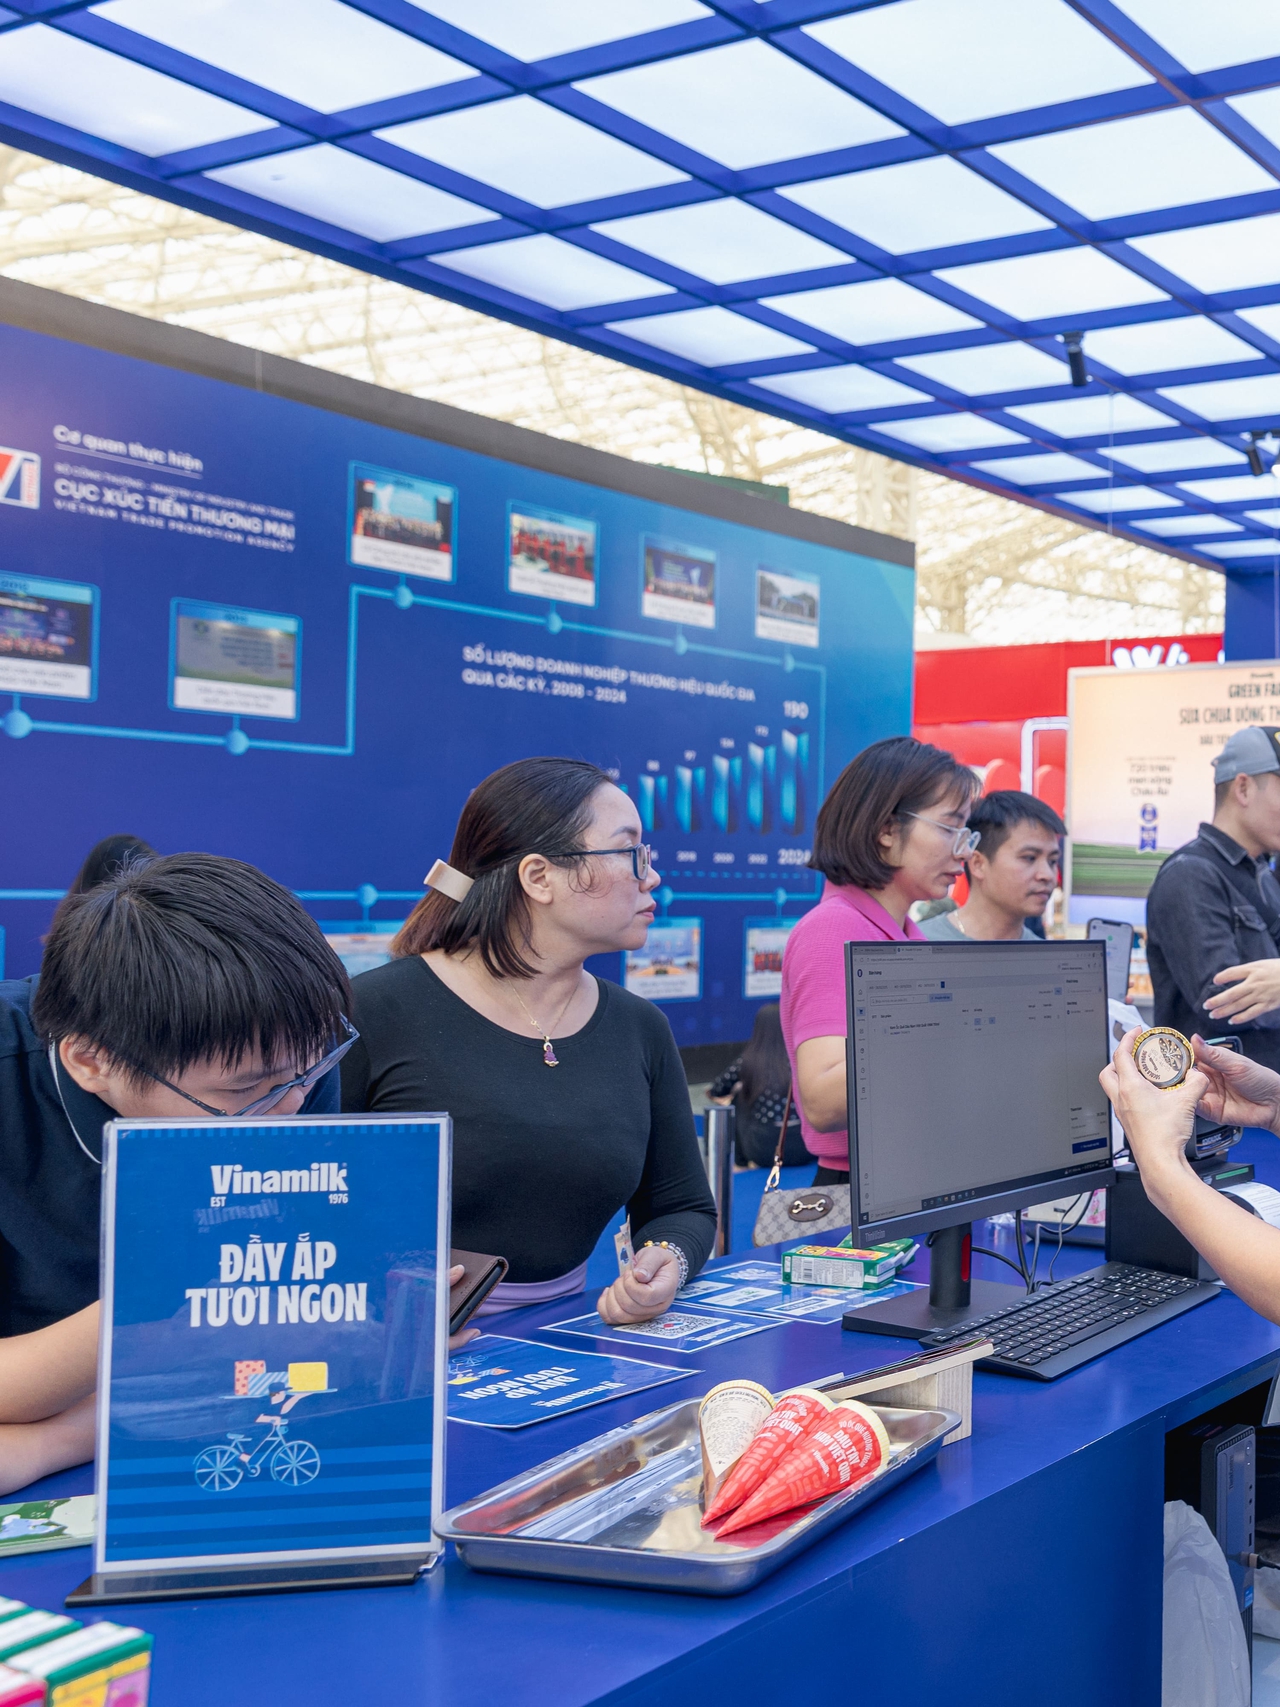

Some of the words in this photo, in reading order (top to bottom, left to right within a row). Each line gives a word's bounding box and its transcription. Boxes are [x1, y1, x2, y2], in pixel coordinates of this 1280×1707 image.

[1229, 684, 1262, 698] GREEN
[210, 1162, 349, 1195] Vinamilk
[210, 1196, 226, 1208] EST
[328, 1194, 349, 1204] 1976
[219, 1234, 288, 1283] ĐẦY
[291, 1232, 337, 1281] ẮP
[185, 1286, 271, 1328] TƯƠI
[277, 1282, 368, 1325] NGON
